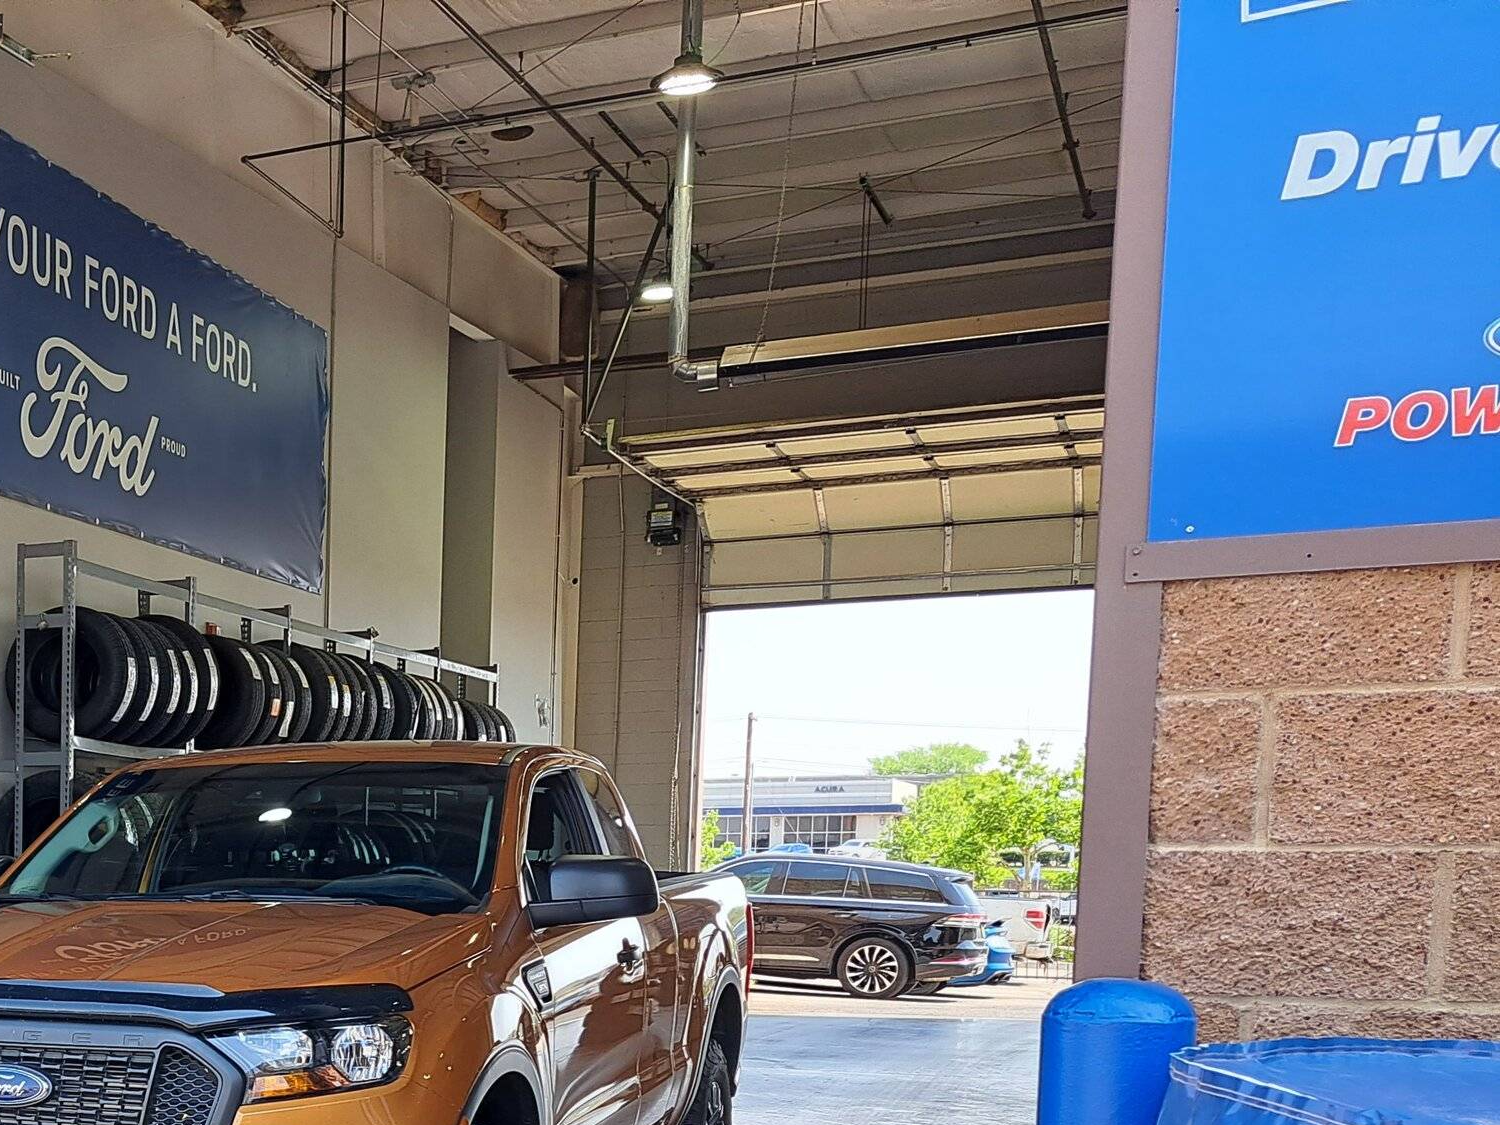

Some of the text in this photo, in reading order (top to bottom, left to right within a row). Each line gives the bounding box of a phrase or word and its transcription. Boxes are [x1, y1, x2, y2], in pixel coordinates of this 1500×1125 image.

[1280, 115, 1500, 201] Driv
[84, 254, 157, 340] FORD
[165, 302, 183, 356] A
[191, 313, 257, 393] FORD.
[20, 336, 159, 497] Ford
[161, 436, 186, 458] PROUD
[814, 785, 845, 793] ACURA
